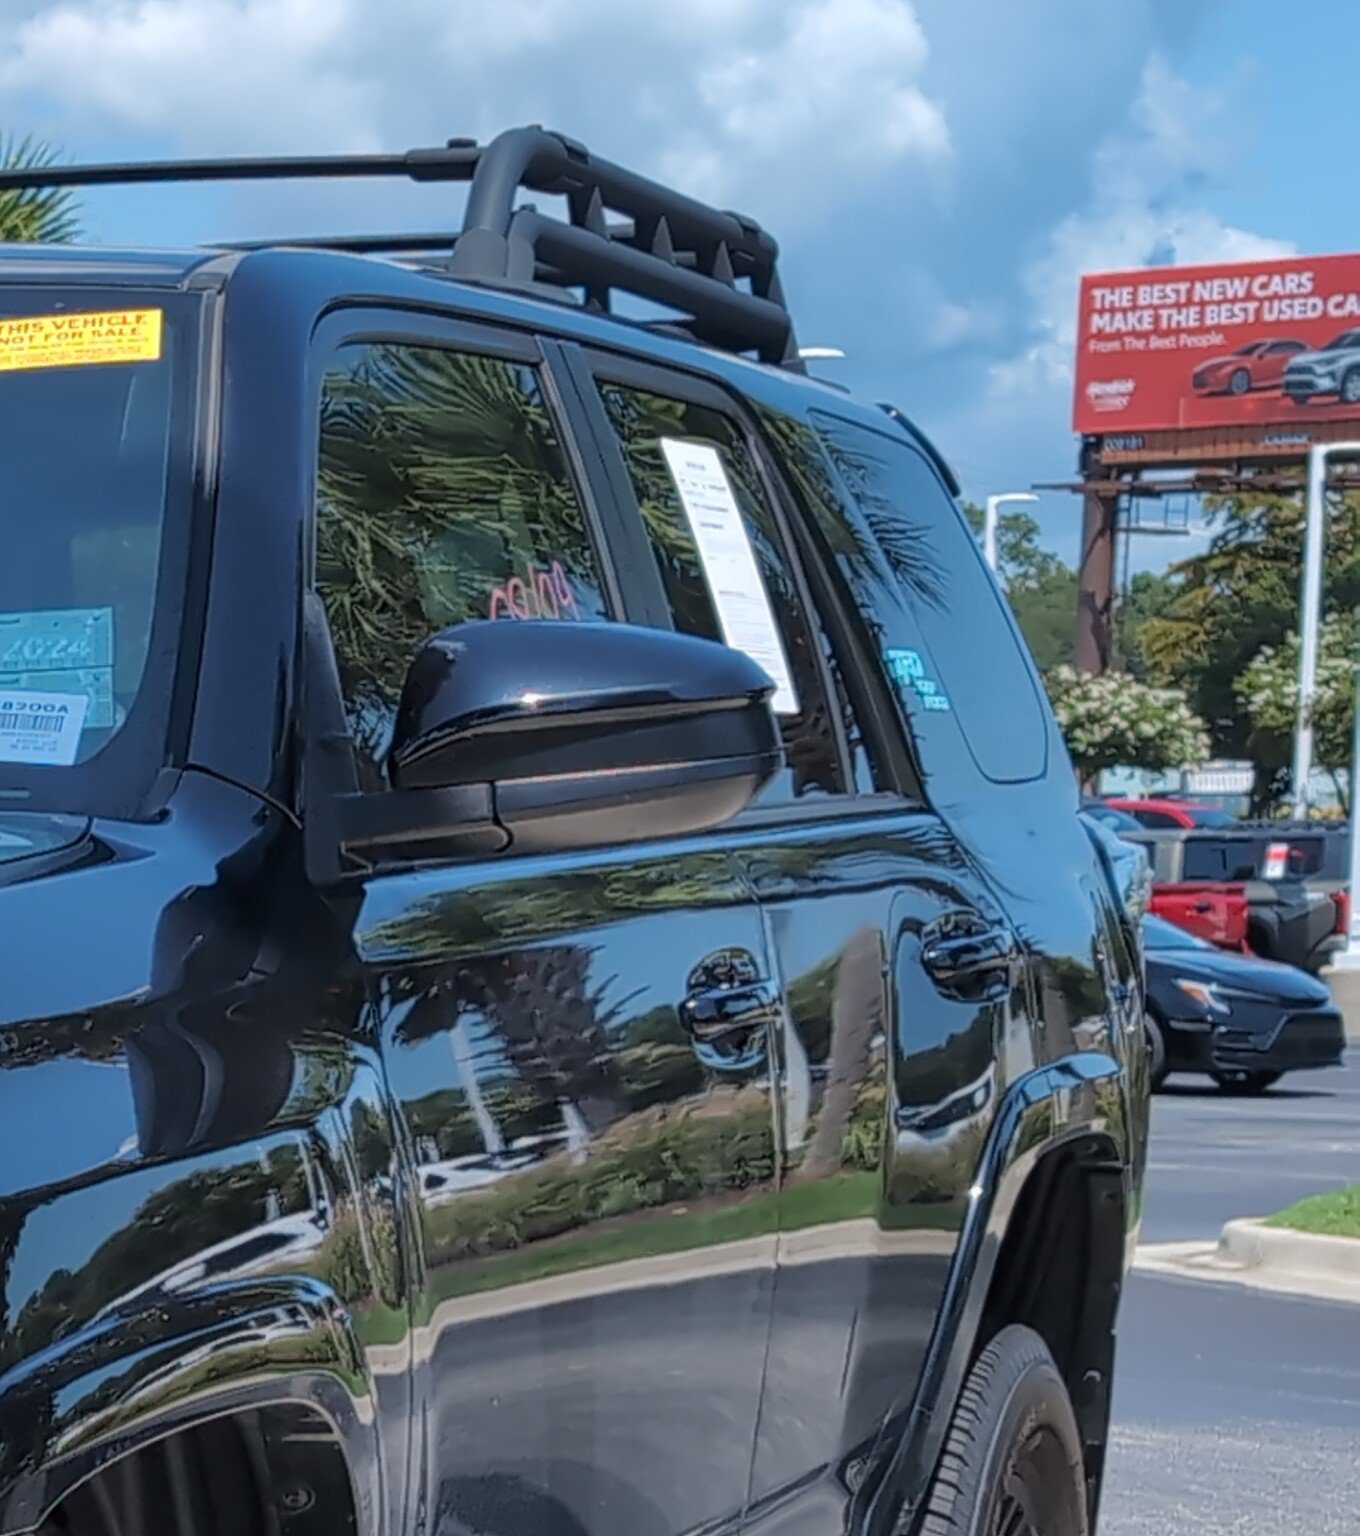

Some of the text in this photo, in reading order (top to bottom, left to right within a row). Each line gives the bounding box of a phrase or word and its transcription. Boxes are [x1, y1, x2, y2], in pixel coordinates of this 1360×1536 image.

[1090, 271, 1315, 309] THE BEST NEW CARS
[51, 314, 148, 330] VEHICLE
[1089, 309, 1154, 333] MAKE
[1157, 305, 1202, 329] THE
[1203, 301, 1260, 325] BEST
[1262, 297, 1324, 320] USED
[43, 331, 84, 342] FOR
[1088, 337, 1121, 354] From
[1123, 335, 1147, 350] The
[1149, 333, 1177, 349] Best
